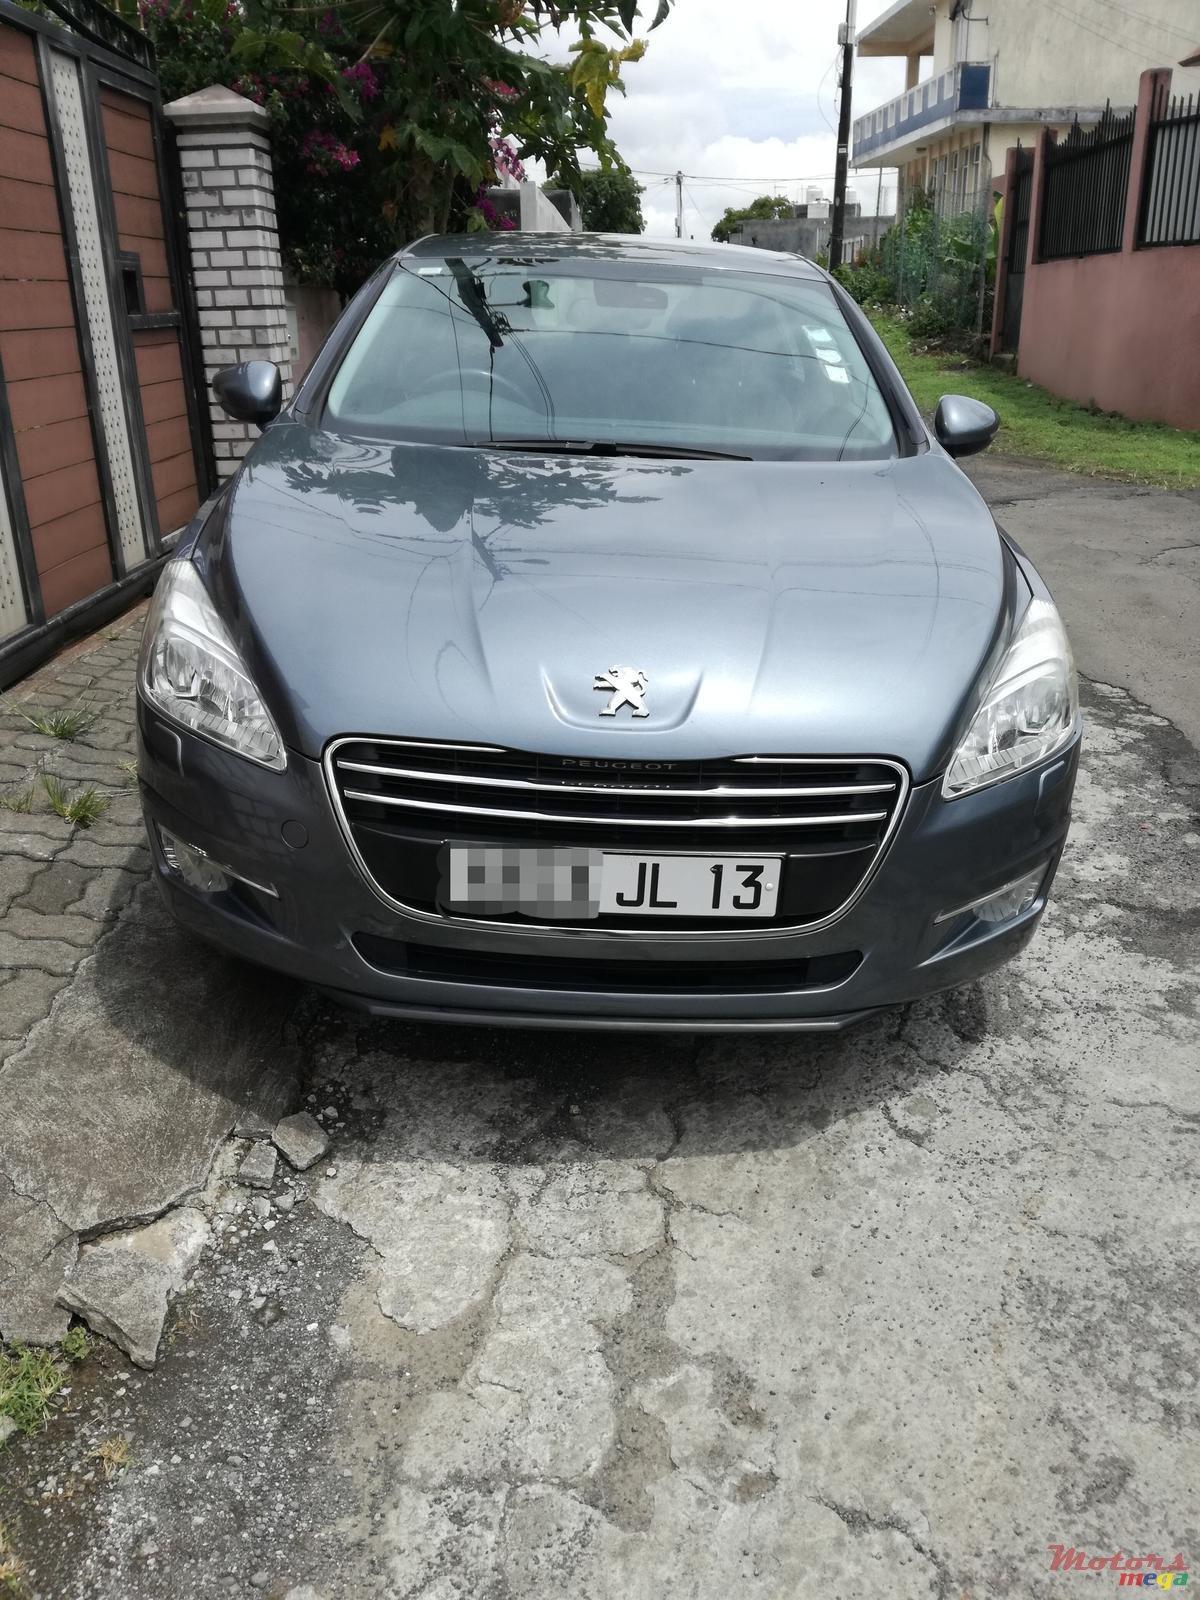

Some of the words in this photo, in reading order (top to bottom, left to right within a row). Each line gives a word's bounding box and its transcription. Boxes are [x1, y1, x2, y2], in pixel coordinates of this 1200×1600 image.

[562, 759, 677, 770] PEUGEOT
[616, 862, 677, 907] JL
[710, 864, 764, 910] 13
